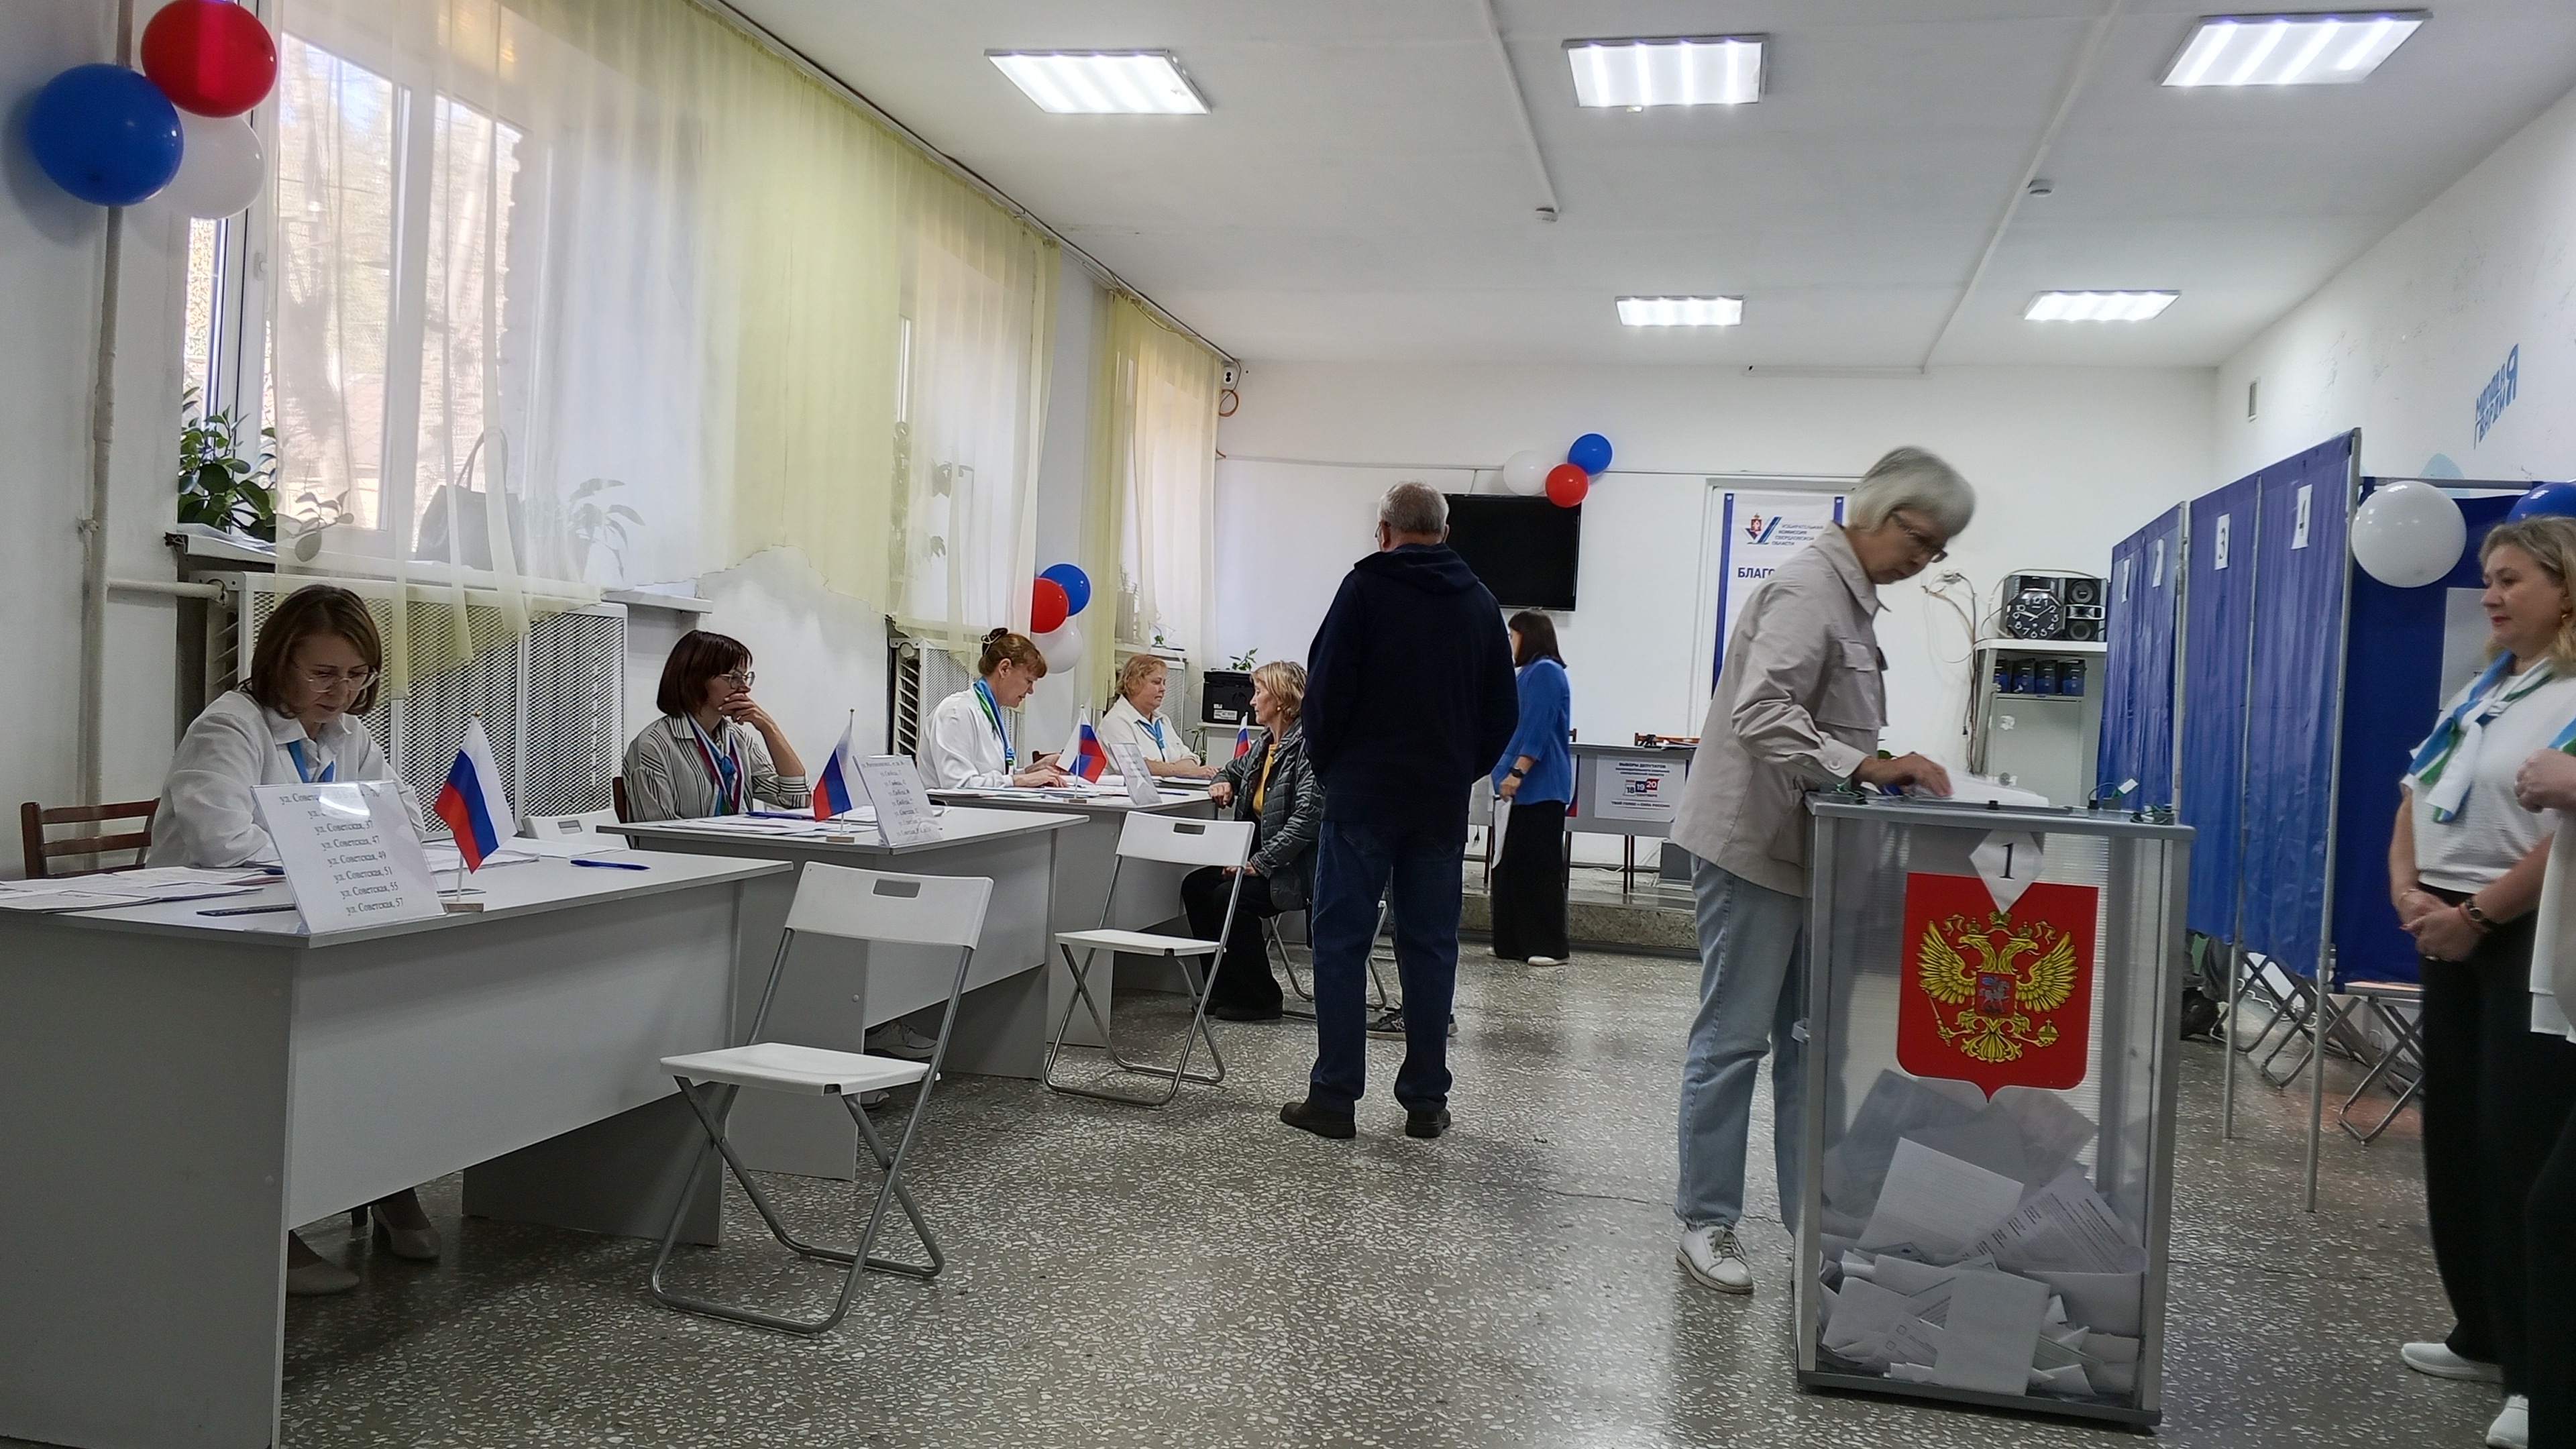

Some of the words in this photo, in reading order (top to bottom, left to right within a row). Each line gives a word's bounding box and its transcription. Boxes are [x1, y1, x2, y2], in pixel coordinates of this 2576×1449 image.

[2218, 527, 2226, 559] 3
[1737, 567, 1775, 579] БЛАГ
[2015, 604, 2026, 612] 10
[2012, 611, 2020, 620] 9
[2051, 614, 2059, 623] 3
[2015, 621, 2023, 629] 8
[2022, 627, 2031, 635] 7
[2047, 623, 2055, 631] 4
[2030, 631, 2038, 639] 6
[2039, 628, 2047, 637] 5
[314, 825, 327, 836] ул.
[327, 822, 365, 833] Советская,
[365, 819, 374, 829] 37
[321, 841, 333, 851] ул.
[333, 838, 372, 849] Советская,
[372, 835, 380, 844] 47
[327, 857, 339, 868] ул.
[339, 854, 378, 864] Советская,
[378, 850, 387, 860] 49
[1999, 842, 2015, 879] 1
[333, 873, 346, 884] ул.
[345, 869, 384, 880] Советская,
[384, 865, 393, 875] 51
[340, 890, 352, 900] ул.
[352, 885, 390, 896] Советская,
[390, 881, 399, 892] 55
[345, 906, 358, 916] ул.
[358, 902, 395, 912] Советская,
[395, 897, 404, 906] 57
